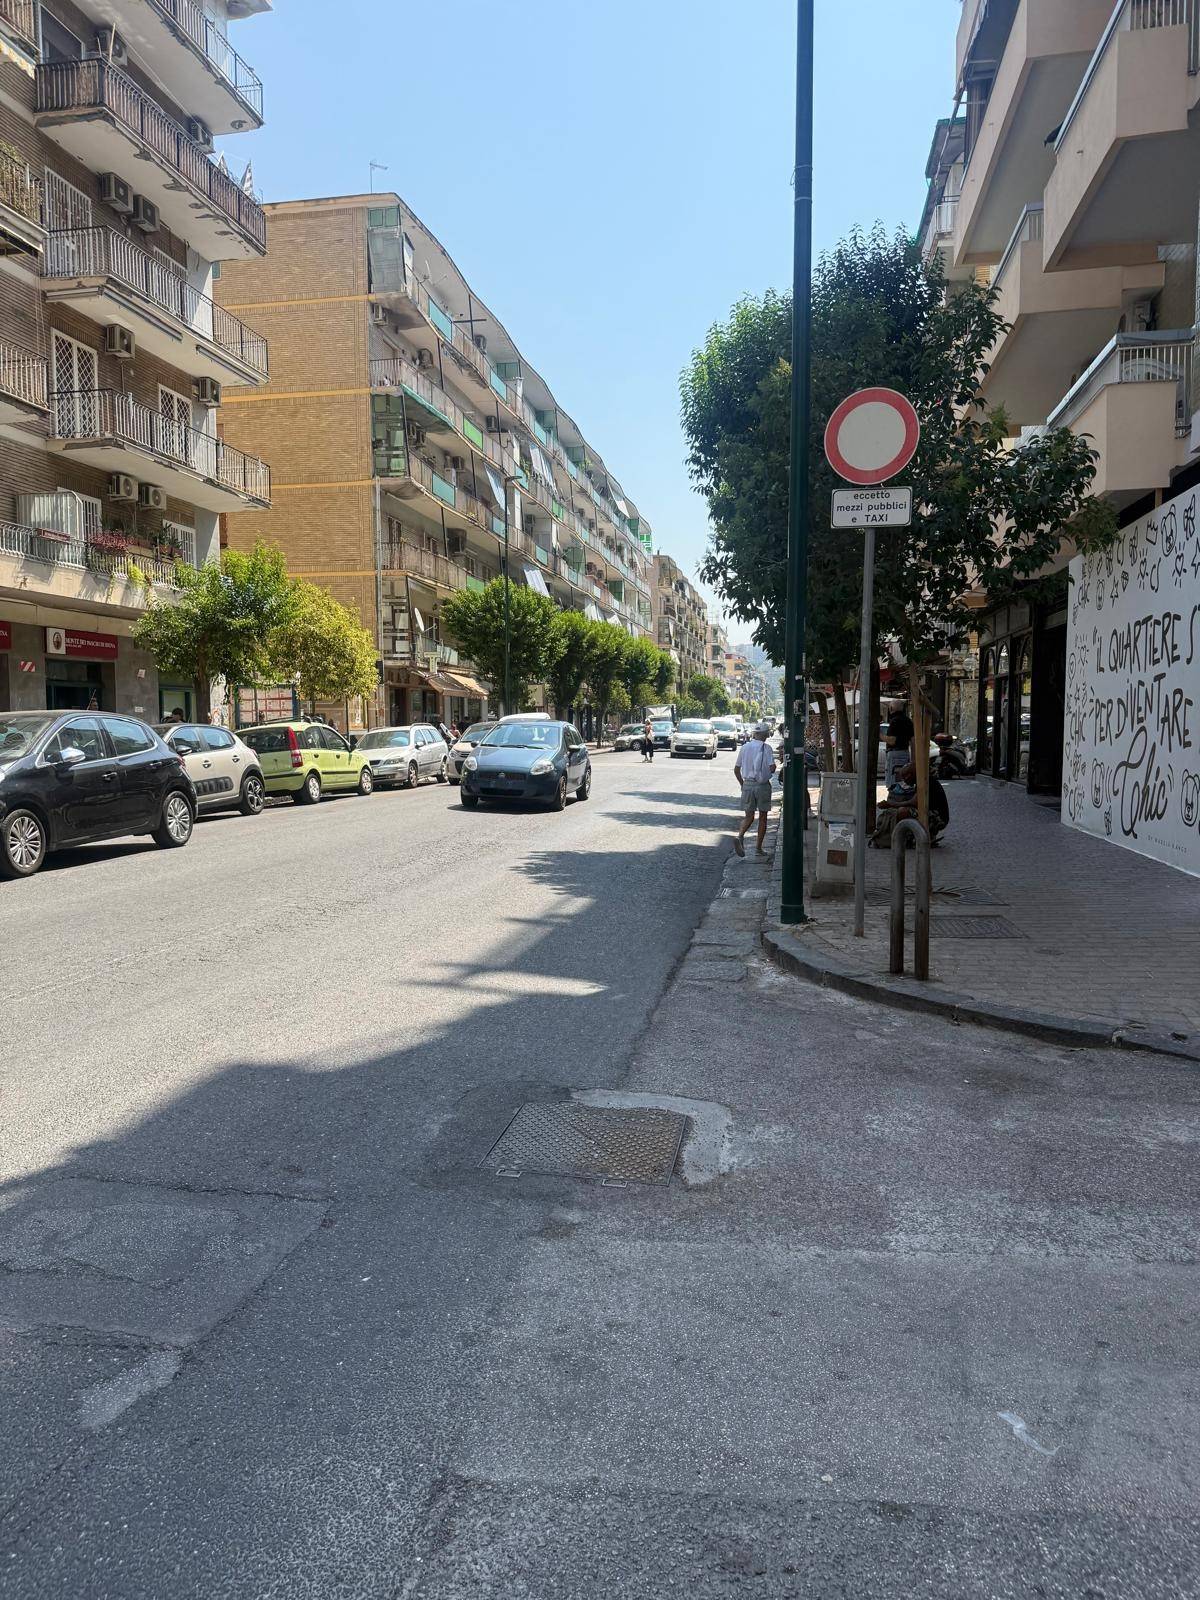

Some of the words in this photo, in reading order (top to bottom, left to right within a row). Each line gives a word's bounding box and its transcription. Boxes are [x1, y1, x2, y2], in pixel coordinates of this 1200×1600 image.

[854, 491, 890, 499] eccetto
[836, 503, 863, 512] mezzi
[867, 501, 907, 512] pubblici
[864, 514, 888, 523] TAXI
[1094, 698, 1113, 746] PER
